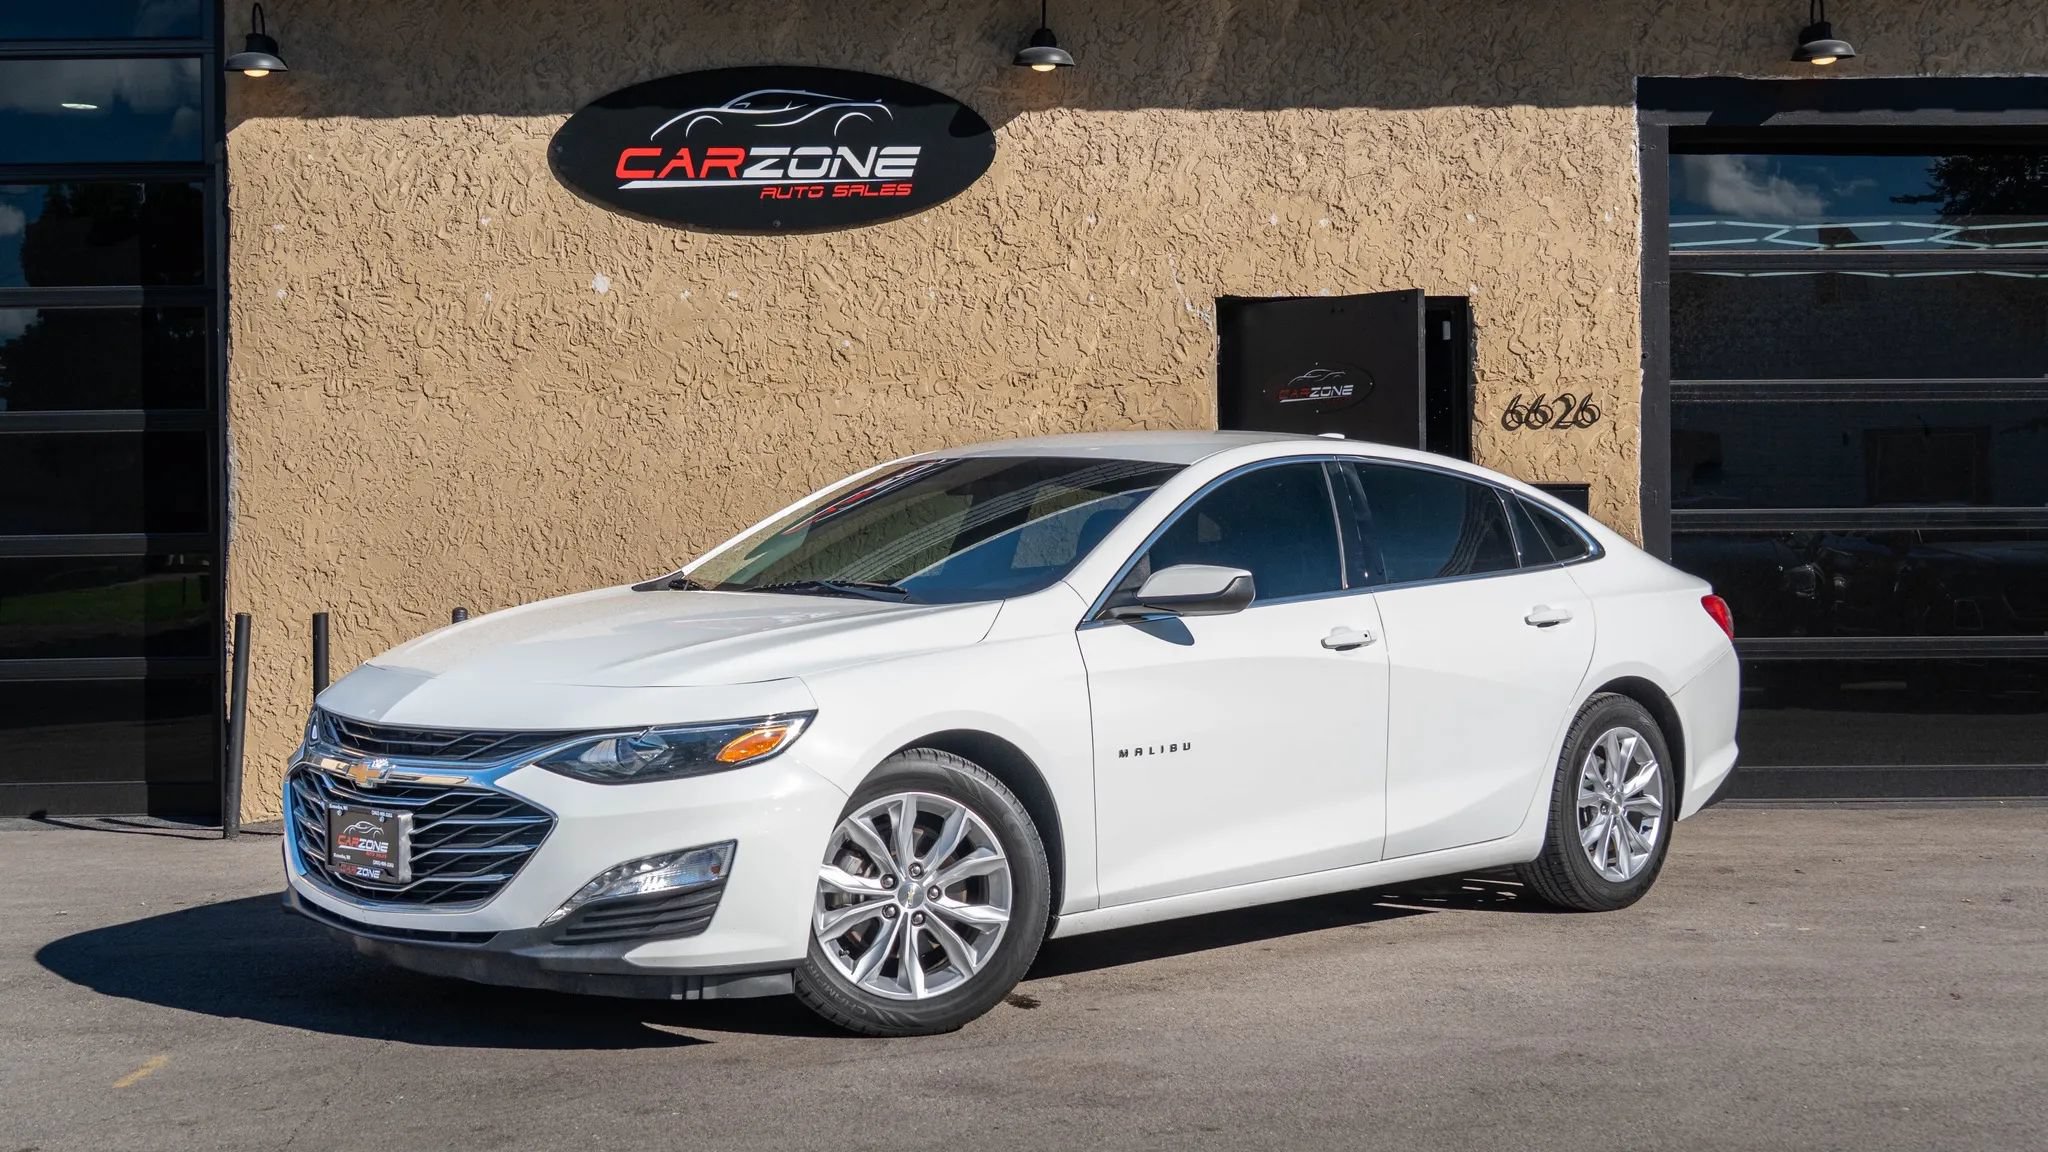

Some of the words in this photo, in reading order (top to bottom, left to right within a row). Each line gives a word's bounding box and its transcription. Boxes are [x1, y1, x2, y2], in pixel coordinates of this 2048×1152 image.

[615, 146, 921, 178] CARZONE
[759, 184, 824, 200] AUTO
[832, 183, 913, 198] SALES
[1501, 392, 1601, 431] 6626
[1118, 741, 1191, 758] MALIBU
[337, 834, 389, 852] CARZONE
